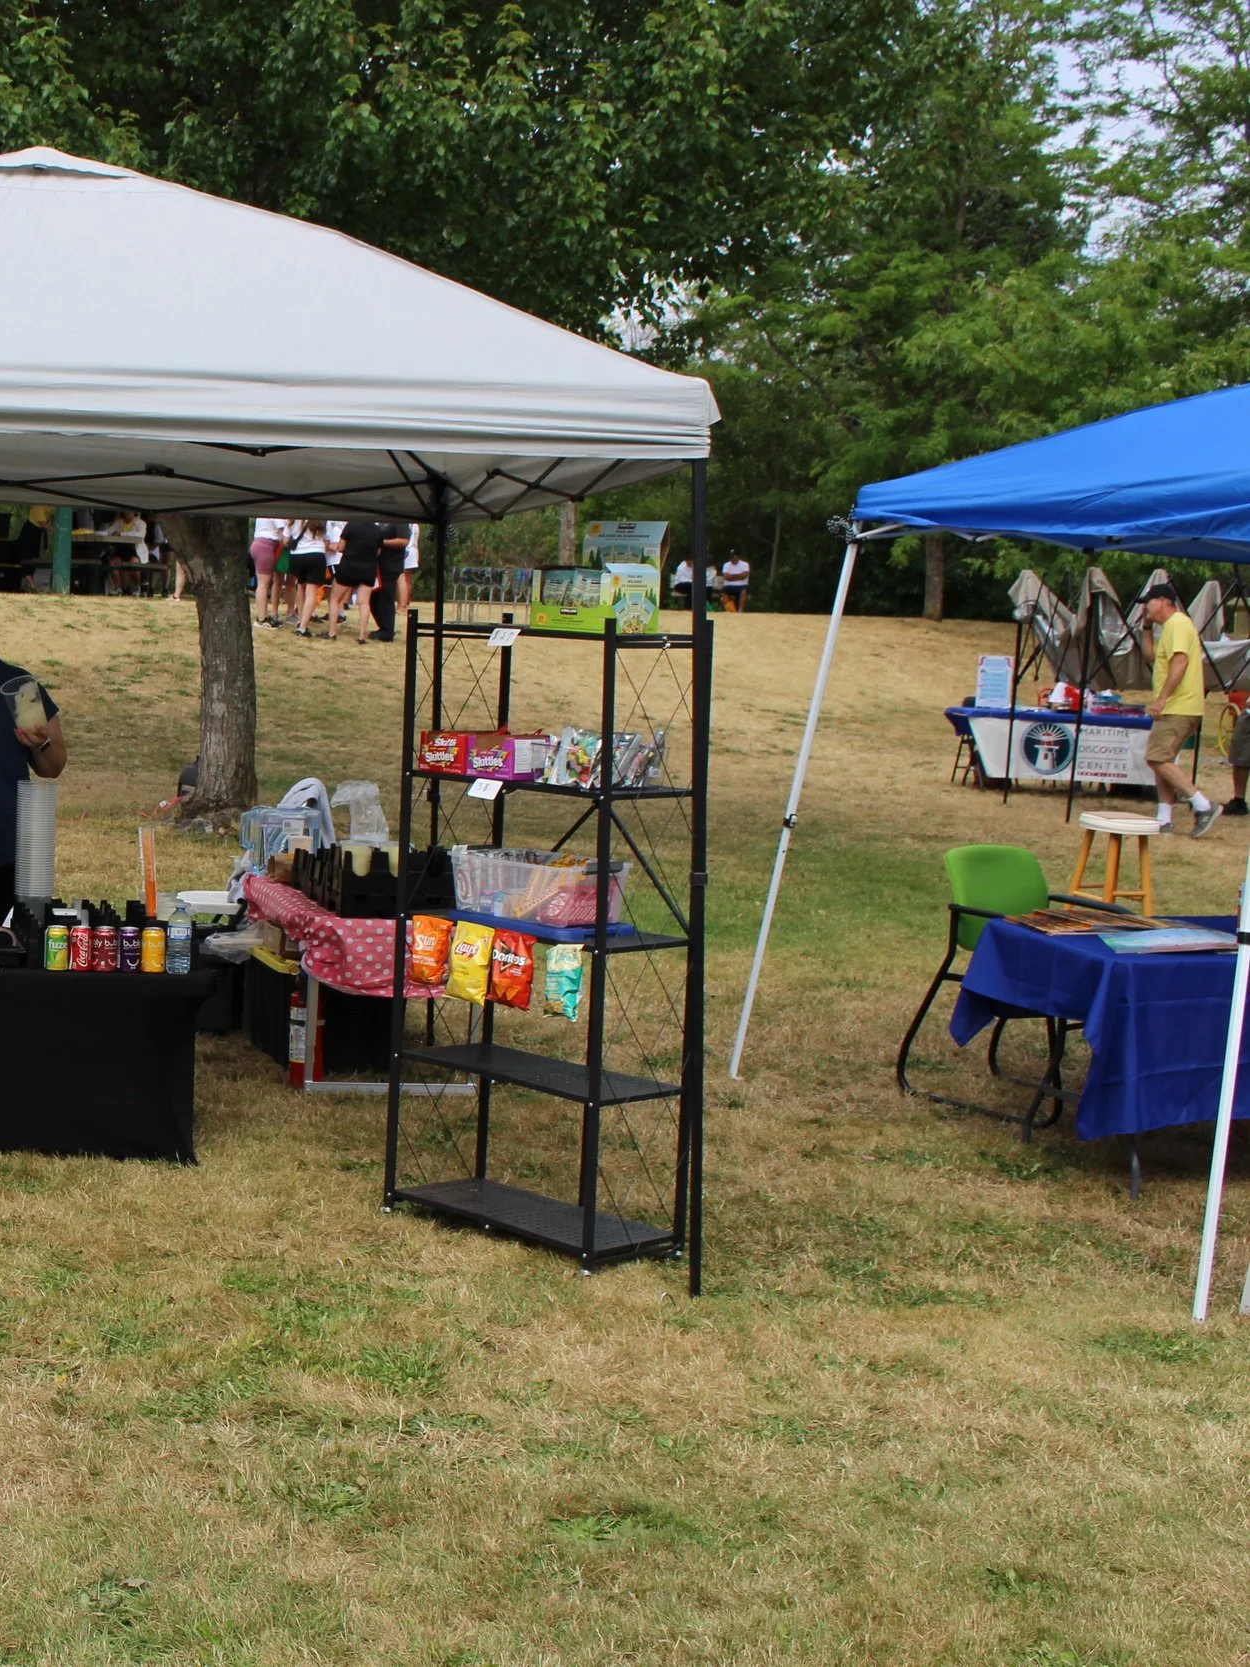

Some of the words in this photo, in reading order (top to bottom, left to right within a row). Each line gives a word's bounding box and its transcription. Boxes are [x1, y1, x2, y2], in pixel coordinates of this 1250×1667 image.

[1080, 727, 1130, 738] MARITIME
[1079, 745, 1129, 755] DISCOVERY
[425, 752, 455, 763] Skittles
[472, 756, 503, 769] Skittles
[1078, 761, 1127, 771] CENTRE
[48, 939, 68, 949] fuze
[493, 949, 527, 967] Doritos
